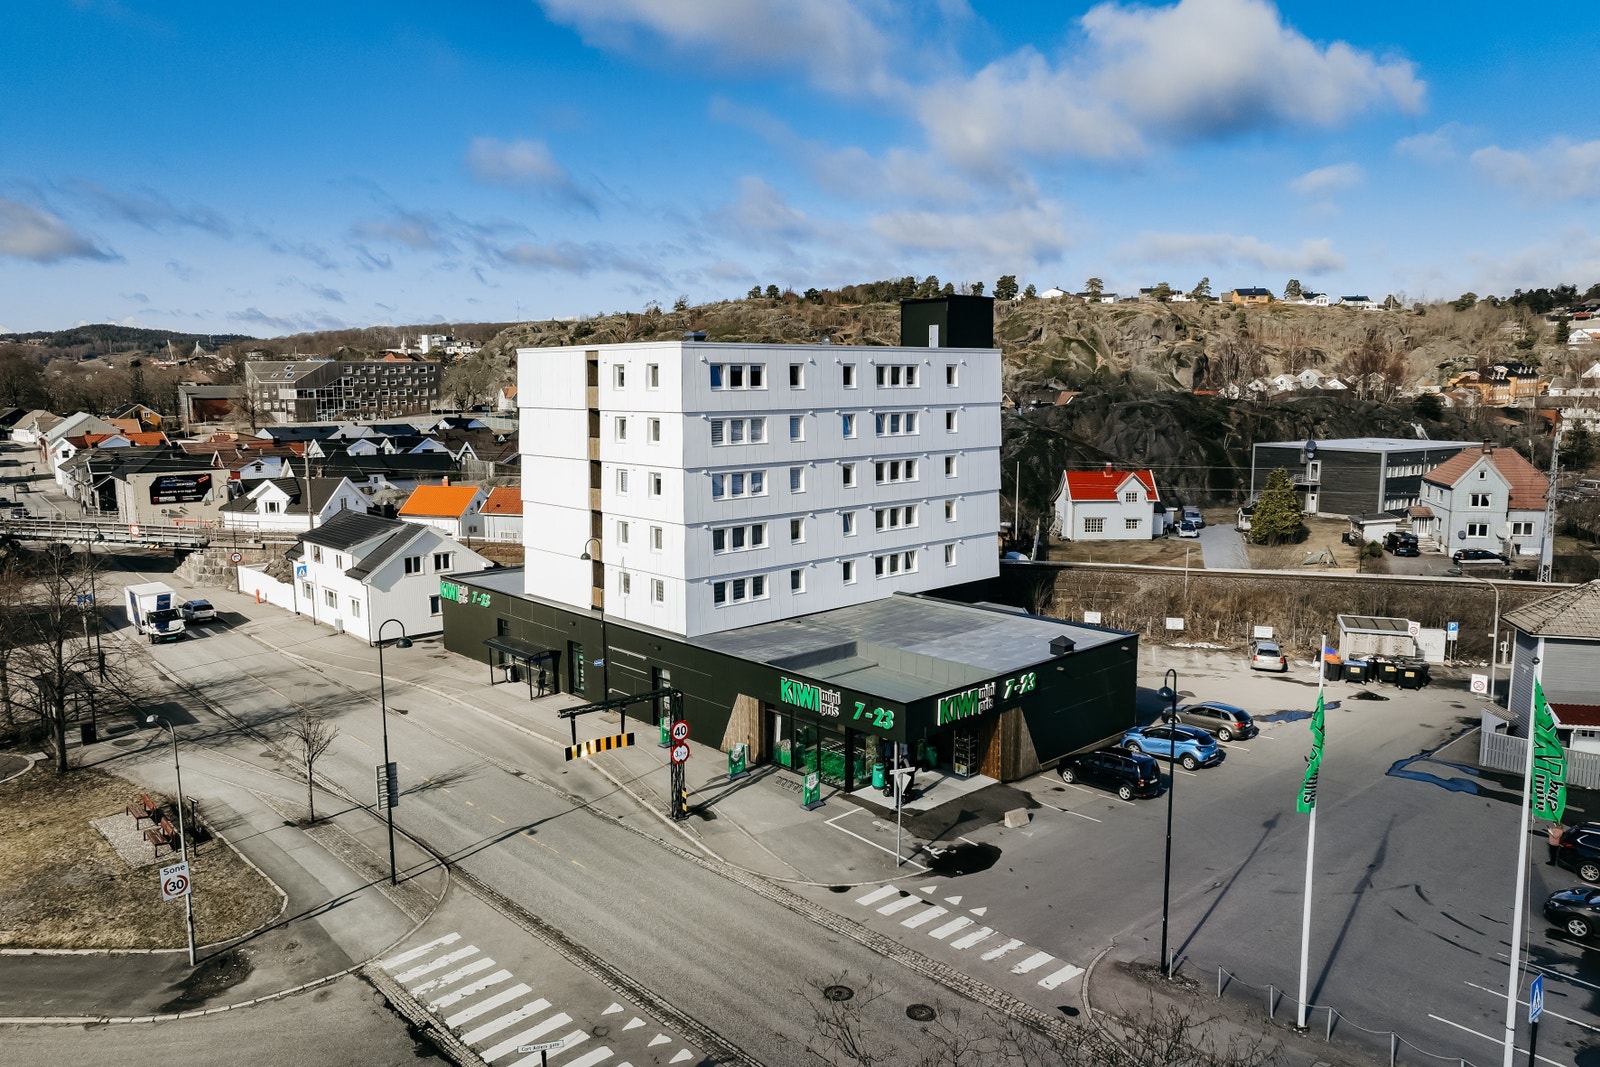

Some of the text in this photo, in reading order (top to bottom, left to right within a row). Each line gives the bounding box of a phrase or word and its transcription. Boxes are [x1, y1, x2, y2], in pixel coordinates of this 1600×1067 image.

[780, 676, 821, 712] KIWI
[979, 682, 996, 699] mini
[1004, 672, 1037, 699] 7-23
[821, 689, 841, 705] mini
[820, 702, 840, 717] pris
[937, 688, 979, 726] KIWI
[978, 697, 994, 715] pris
[853, 701, 895, 730] 7-23
[674, 725, 687, 736] 40
[163, 864, 185, 875] Sone
[168, 879, 184, 891] 30
